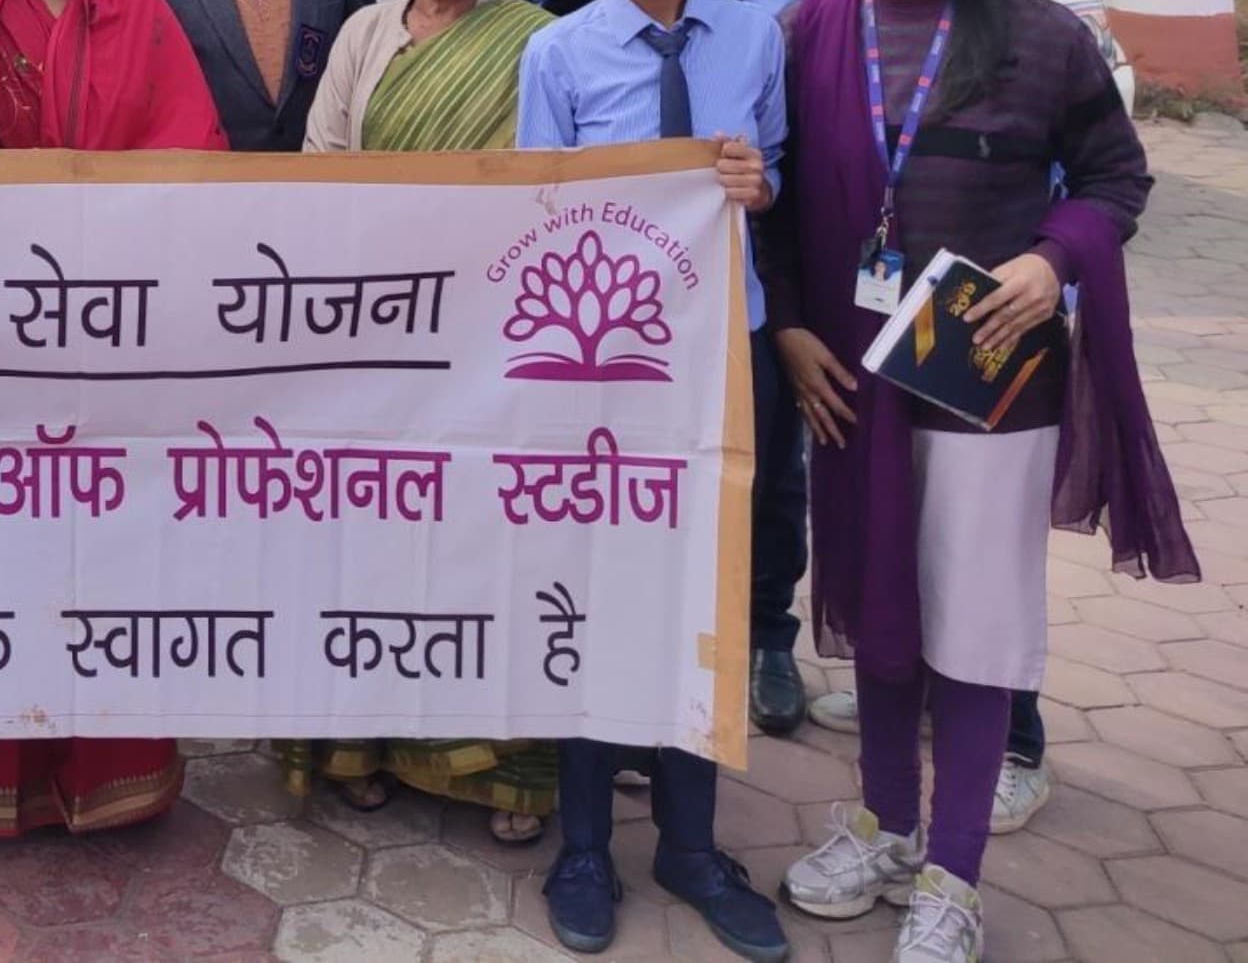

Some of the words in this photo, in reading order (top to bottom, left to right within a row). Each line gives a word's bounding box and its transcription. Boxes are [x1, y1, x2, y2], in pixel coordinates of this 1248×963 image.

[4, 243, 159, 349] सेवा
[213, 242, 456, 343] योजना
[486, 229, 539, 283] Grow
[543, 203, 594, 233] with
[602, 201, 700, 291] Education
[166, 415, 452, 523] प्रोफेशनल
[492, 426, 688, 529] स्टडीज
[60, 609, 274, 679] स्वागत
[319, 610, 494, 680] करता
[536, 581, 587, 687] है
